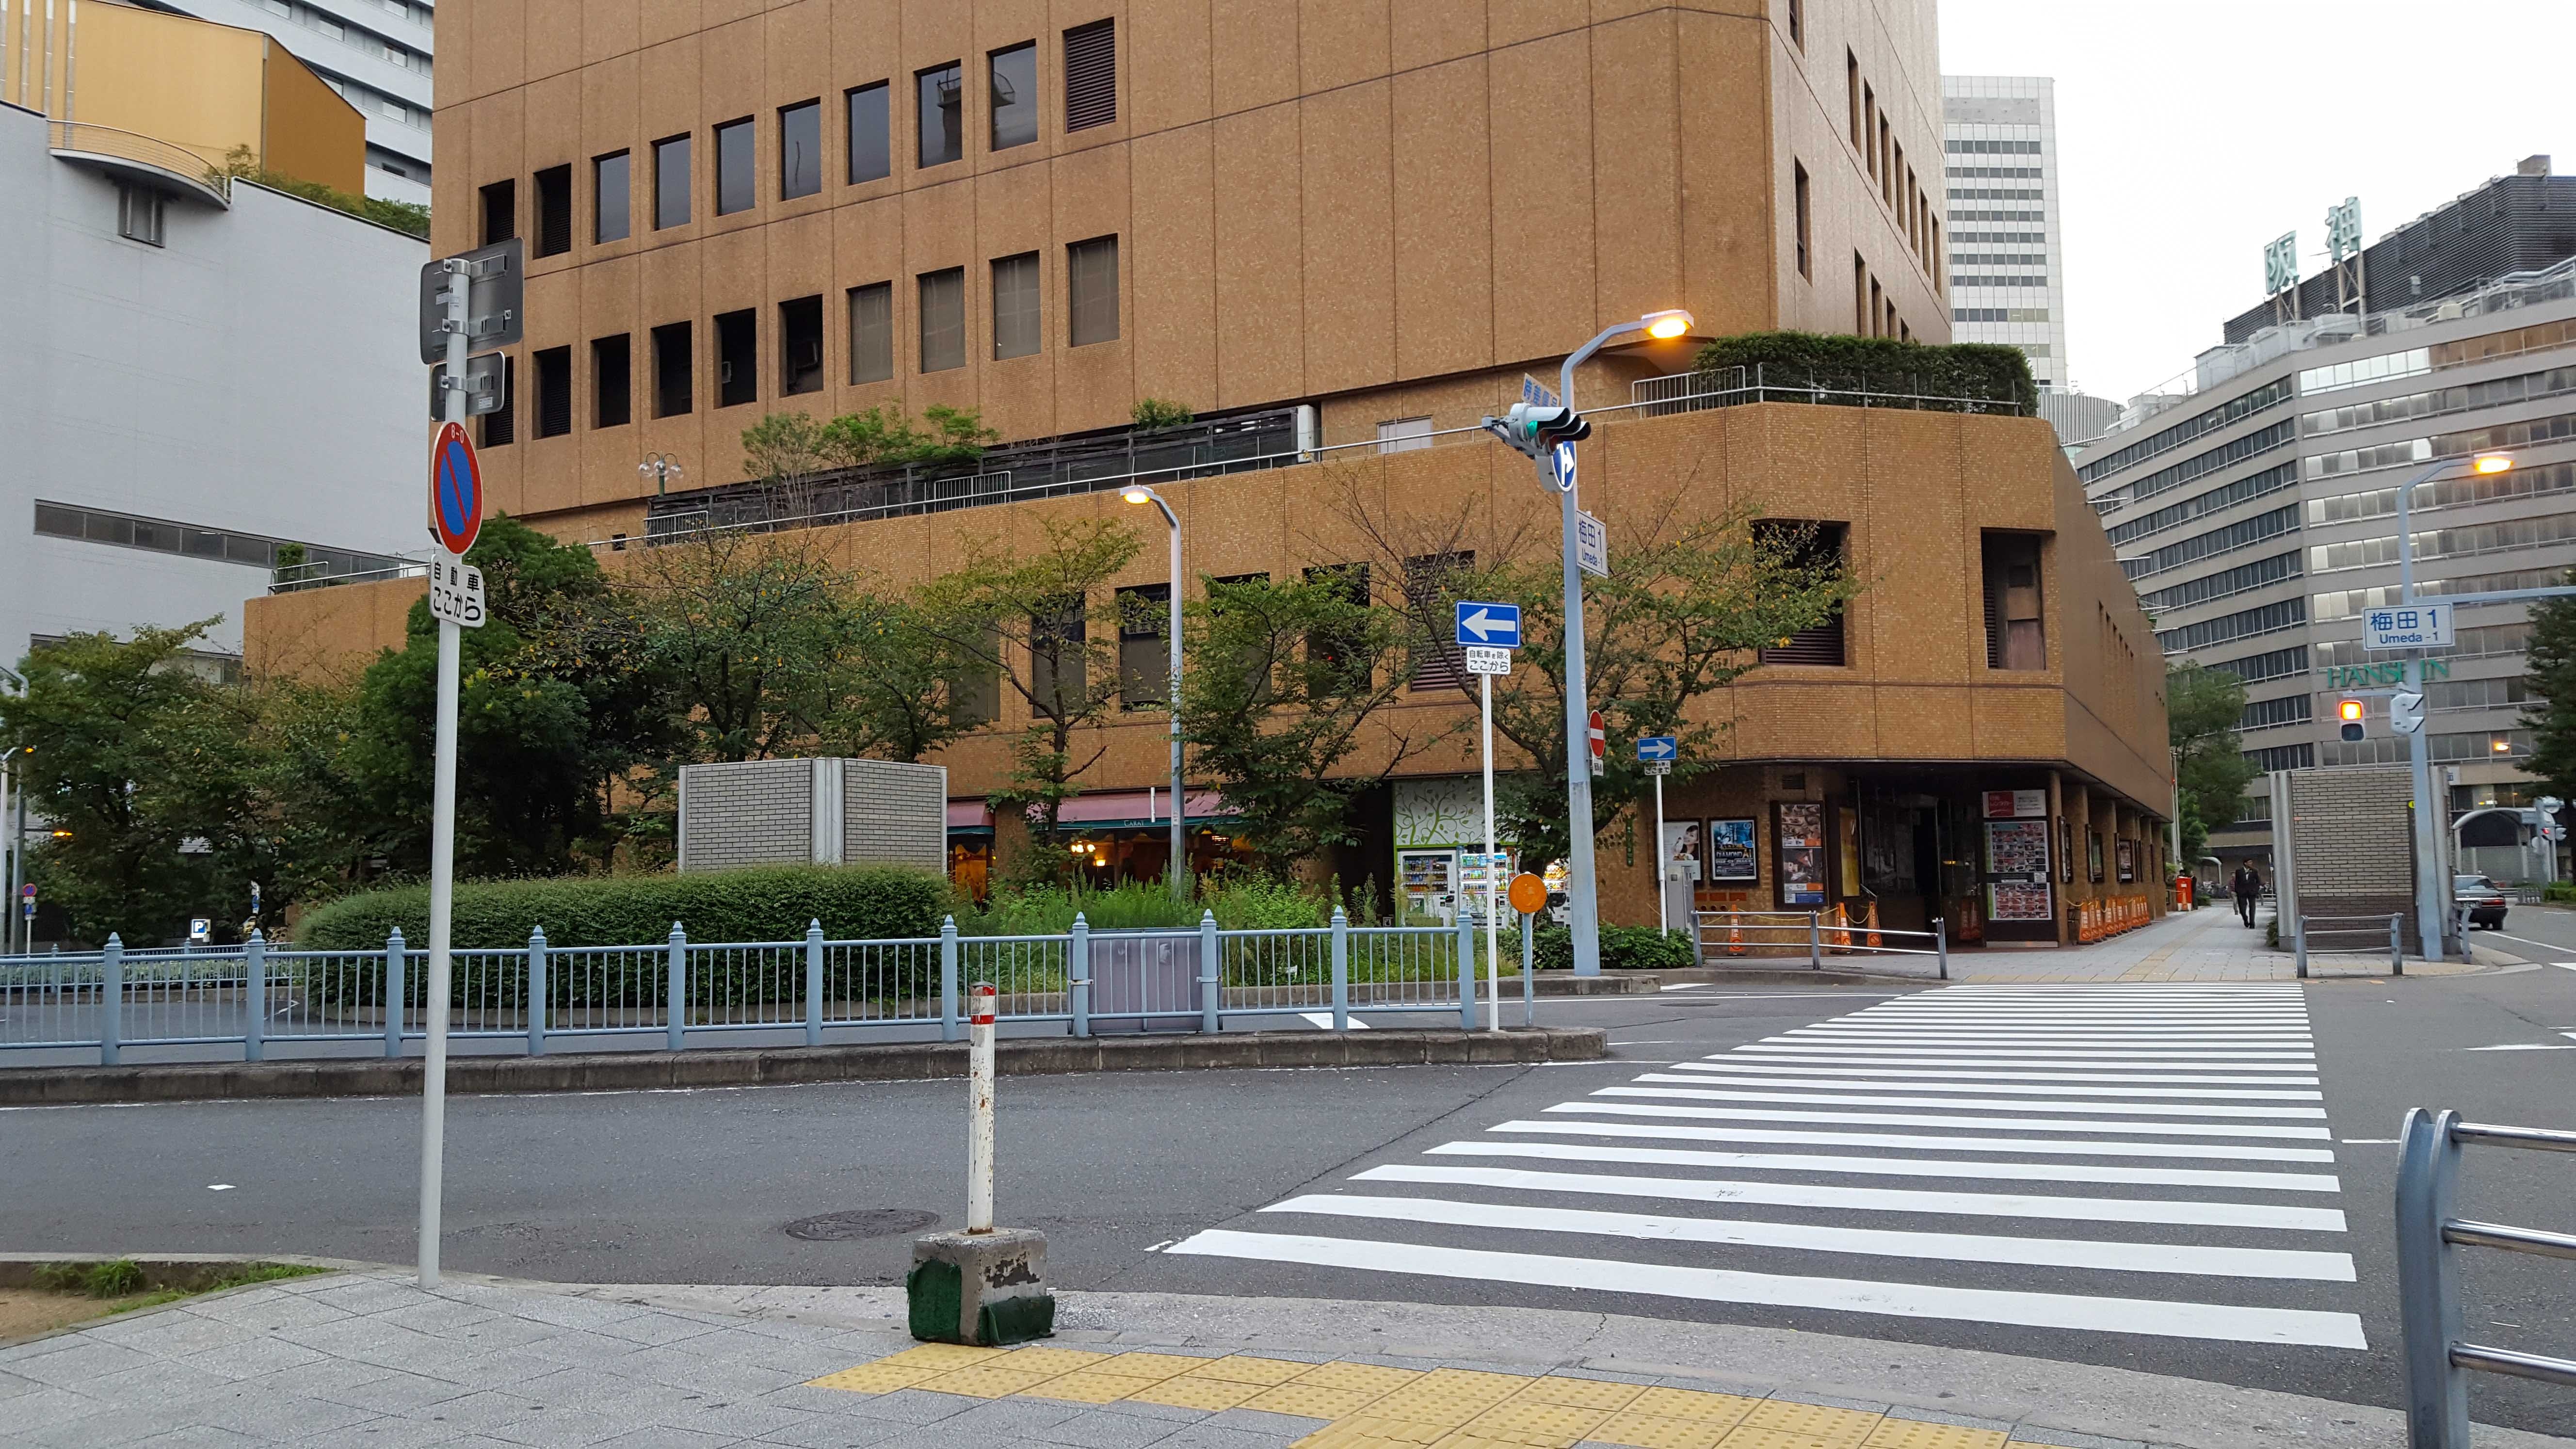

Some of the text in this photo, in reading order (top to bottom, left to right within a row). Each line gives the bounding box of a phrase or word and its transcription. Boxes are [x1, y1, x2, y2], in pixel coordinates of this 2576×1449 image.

[2264, 196, 2362, 295] 阪神
[435, 561, 480, 592] 自動車
[434, 586, 481, 621] ここから
[1469, 650, 1509, 660] 自転車を除く
[1470, 660, 1509, 672] ここから
[195, 921, 203, 932] P
